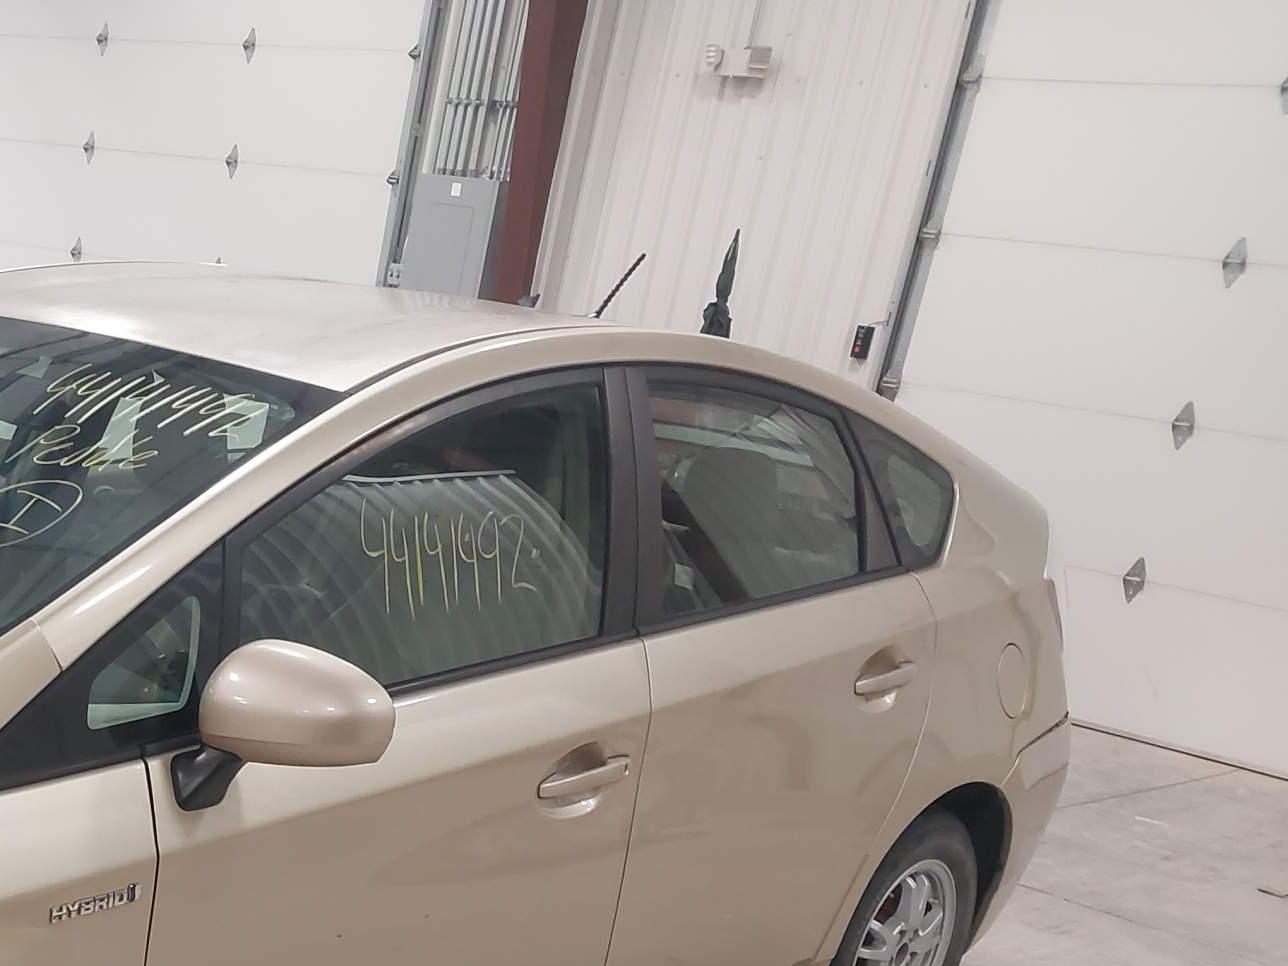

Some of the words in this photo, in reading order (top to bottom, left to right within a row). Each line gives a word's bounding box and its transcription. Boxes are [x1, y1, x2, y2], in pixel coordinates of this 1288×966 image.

[33, 363, 271, 443] 44141492
[360, 496, 538, 622] 44141492
[48, 888, 128, 924] HYBRID
